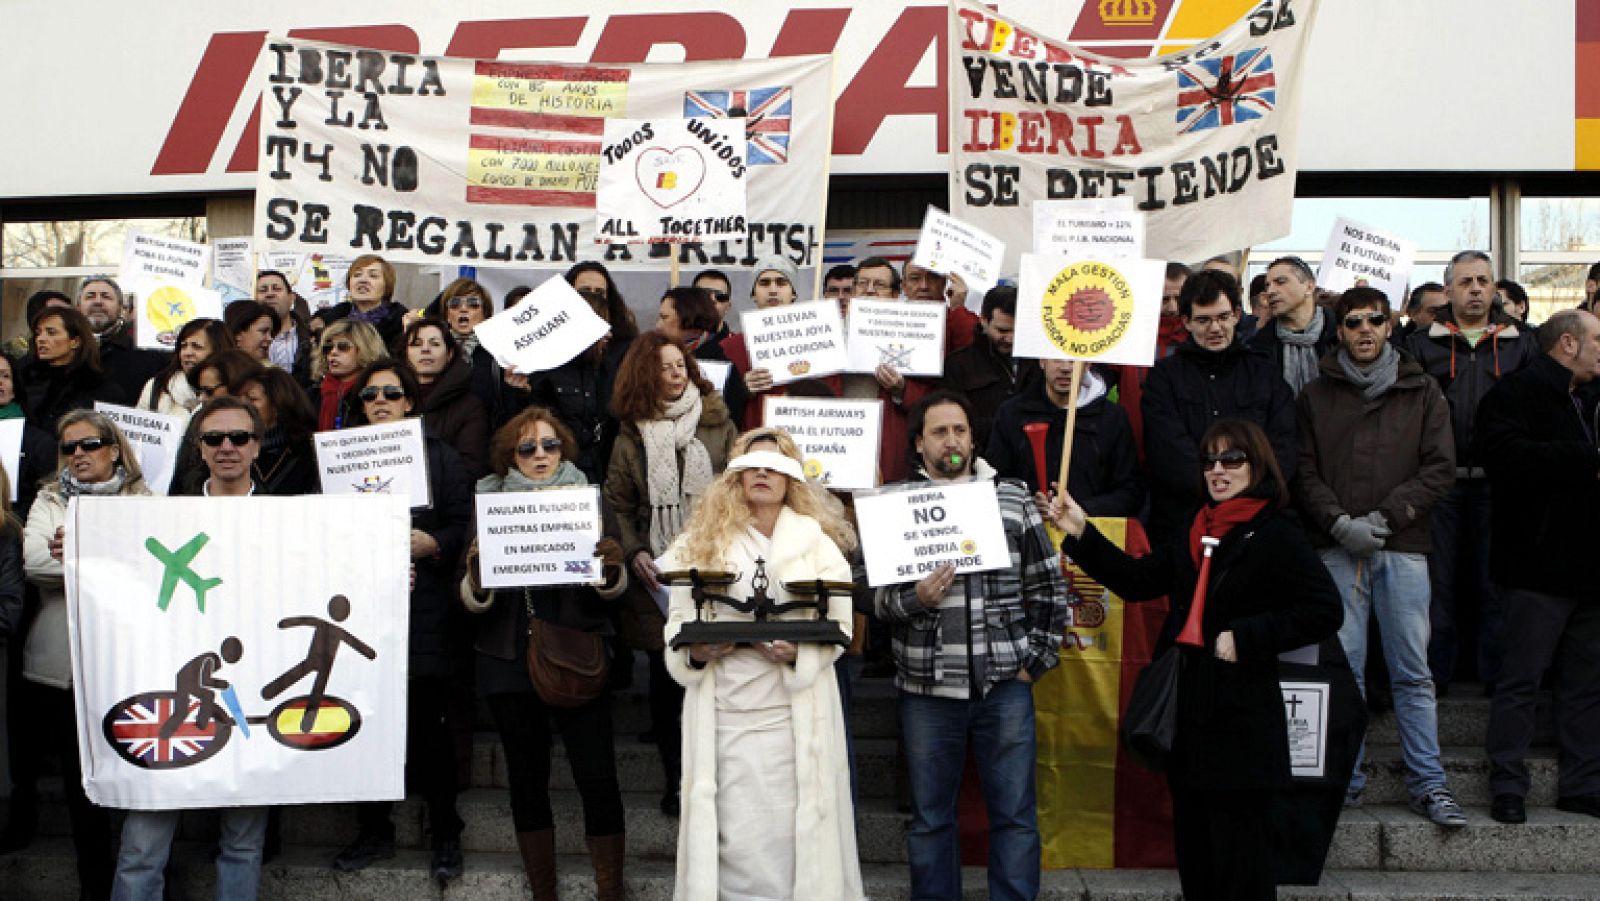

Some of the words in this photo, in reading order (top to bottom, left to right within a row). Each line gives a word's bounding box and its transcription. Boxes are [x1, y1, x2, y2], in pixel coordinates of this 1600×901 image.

[959, 8, 1137, 76] IBE
[269, 43, 446, 96] IBERIA
[962, 55, 1113, 107] VENDE
[273, 85, 303, 128] Y
[324, 91, 388, 130] LA
[509, 92, 527, 105] DE
[538, 94, 613, 111] HISTORIA
[962, 109, 1142, 158] IBERIA
[602, 122, 655, 165] TODOS
[266, 135, 334, 182] T4
[360, 143, 418, 192] NO
[964, 162, 1020, 207] SE
[1046, 134, 1284, 211] DEFIENDE
[266, 198, 331, 244] SE
[349, 204, 579, 263] REGALAN
[601, 216, 638, 236] ALL
[660, 214, 746, 235] TOGETHER
[1068, 220, 1106, 229] TURISMO
[1092, 235, 1134, 243] NACIONAL
[1344, 224, 1364, 240] NOS
[1365, 232, 1401, 253] ROBAN
[1340, 241, 1351, 253] EL
[1354, 245, 1395, 265] FUTURO
[1335, 257, 1350, 269] DE
[1047, 268, 1079, 296] MALA
[511, 304, 540, 326] NOS
[762, 315, 775, 327] SE
[777, 310, 818, 325] LLEVAN
[753, 327, 803, 345] NUESTRA
[805, 323, 833, 338] JOYA
[1070, 341, 1088, 354] NO
[1090, 312, 1132, 353] GRACIAS
[756, 350, 772, 361] DE
[773, 347, 787, 358] LA
[788, 339, 836, 356] CORONA
[774, 406, 815, 417] BRITISH
[817, 408, 865, 419] AIRWAYS
[164, 422, 170, 432] A
[807, 426, 818, 437] EL
[820, 426, 863, 437] FUTURO
[321, 439, 338, 448] NOS
[805, 441, 846, 454] ESPAÑA
[327, 460, 369, 475] NUESTRO
[371, 454, 413, 468] TURISMO
[907, 492, 945, 504] IBERIA
[487, 505, 525, 516] ANULAN
[527, 504, 538, 514] EL
[539, 503, 577, 513] FUTURO
[579, 502, 591, 511] DE
[913, 506, 946, 525] NO
[487, 523, 538, 535] NUESTRAS
[541, 521, 592, 533] EMPRESAS
[904, 531, 919, 541] SE
[504, 545, 517, 555] EN
[520, 542, 576, 554] MERCADOS
[914, 542, 959, 557] IBERIA
[493, 562, 557, 575] EMERGENTES
[896, 564, 914, 577] SE
